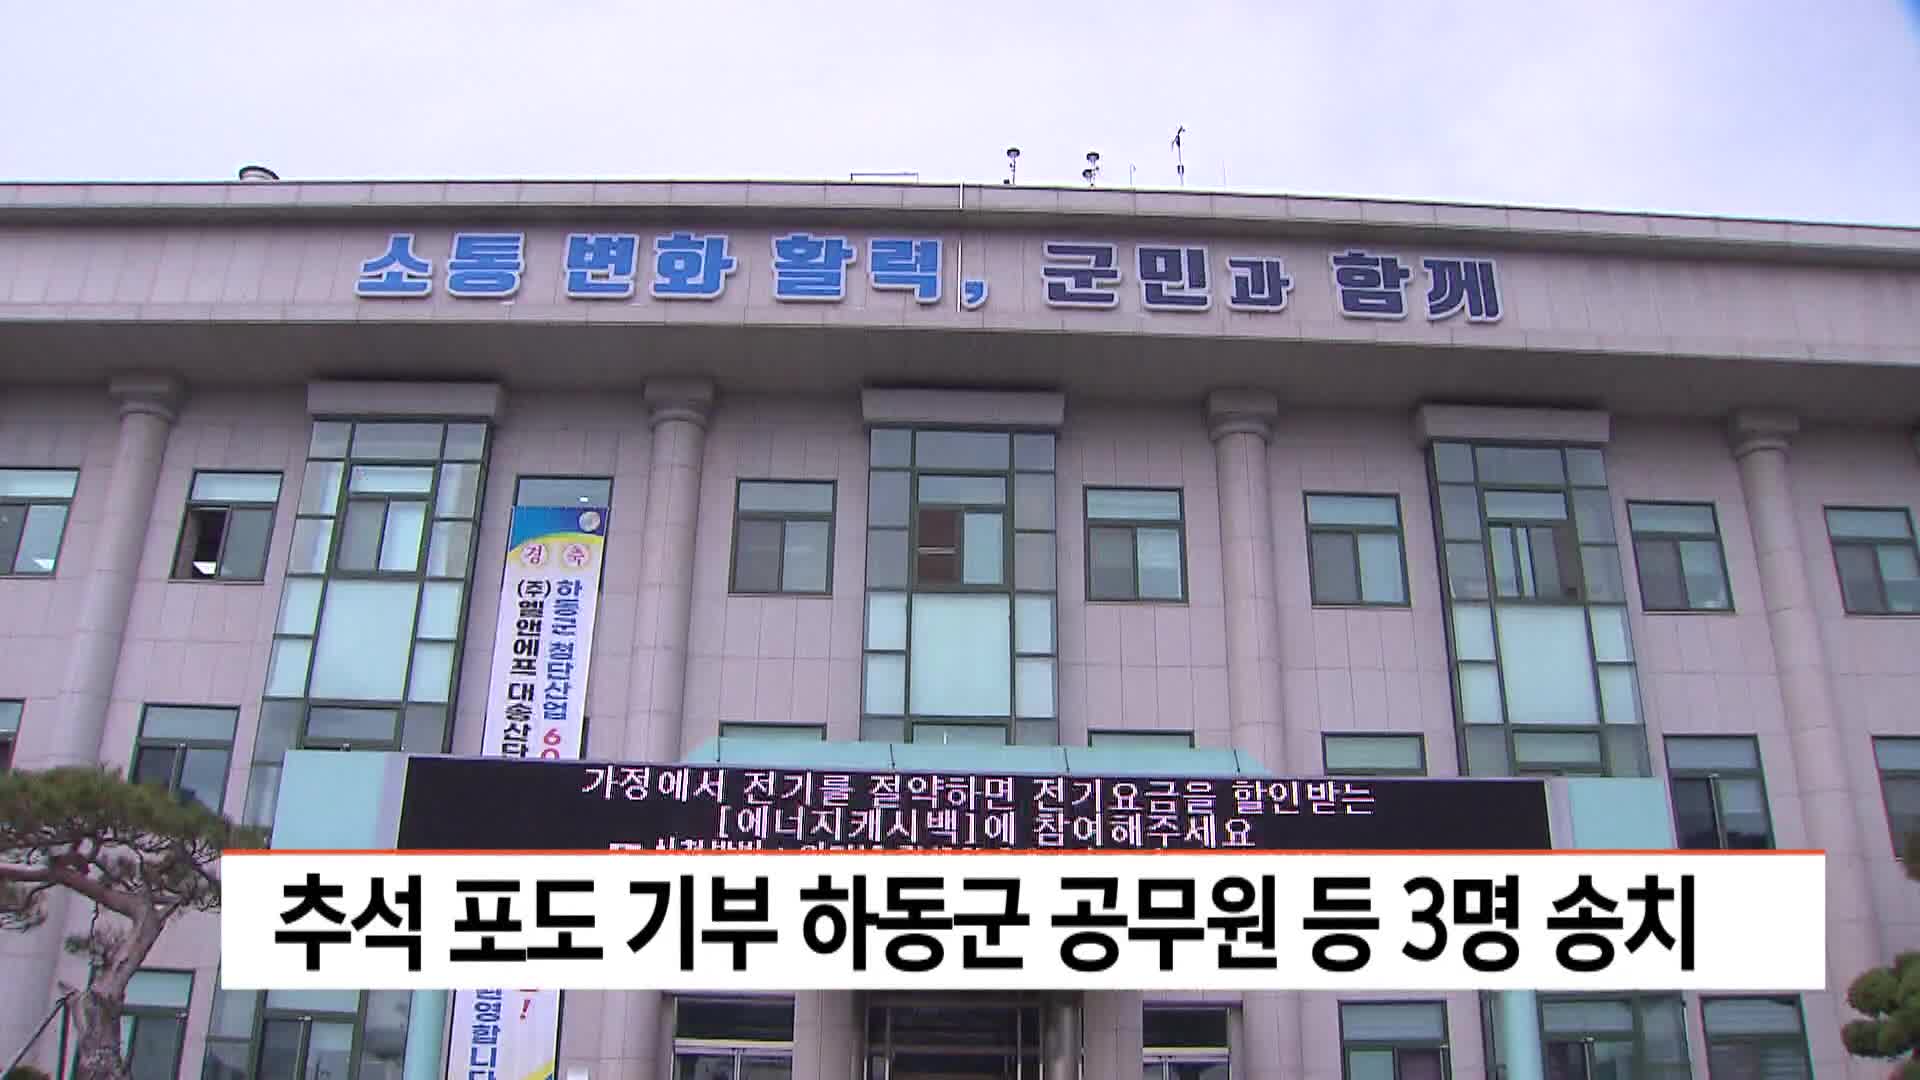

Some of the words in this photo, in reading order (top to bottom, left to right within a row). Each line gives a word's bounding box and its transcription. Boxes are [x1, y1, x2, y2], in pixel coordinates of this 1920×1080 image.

[355, 232, 525, 298] 소통
[564, 231, 738, 299] 변화
[770, 233, 990, 310] 활력,
[1041, 241, 1294, 312] 군민과
[1328, 249, 1504, 322] 함께
[582, 765, 724, 802] 가정에서
[743, 769, 853, 806] 전기를
[870, 772, 1013, 811] 절약하며
[1032, 777, 1217, 816] 전기요금을
[1231, 780, 1375, 815] 할인받는
[1034, 813, 1257, 849] 참여해주세요
